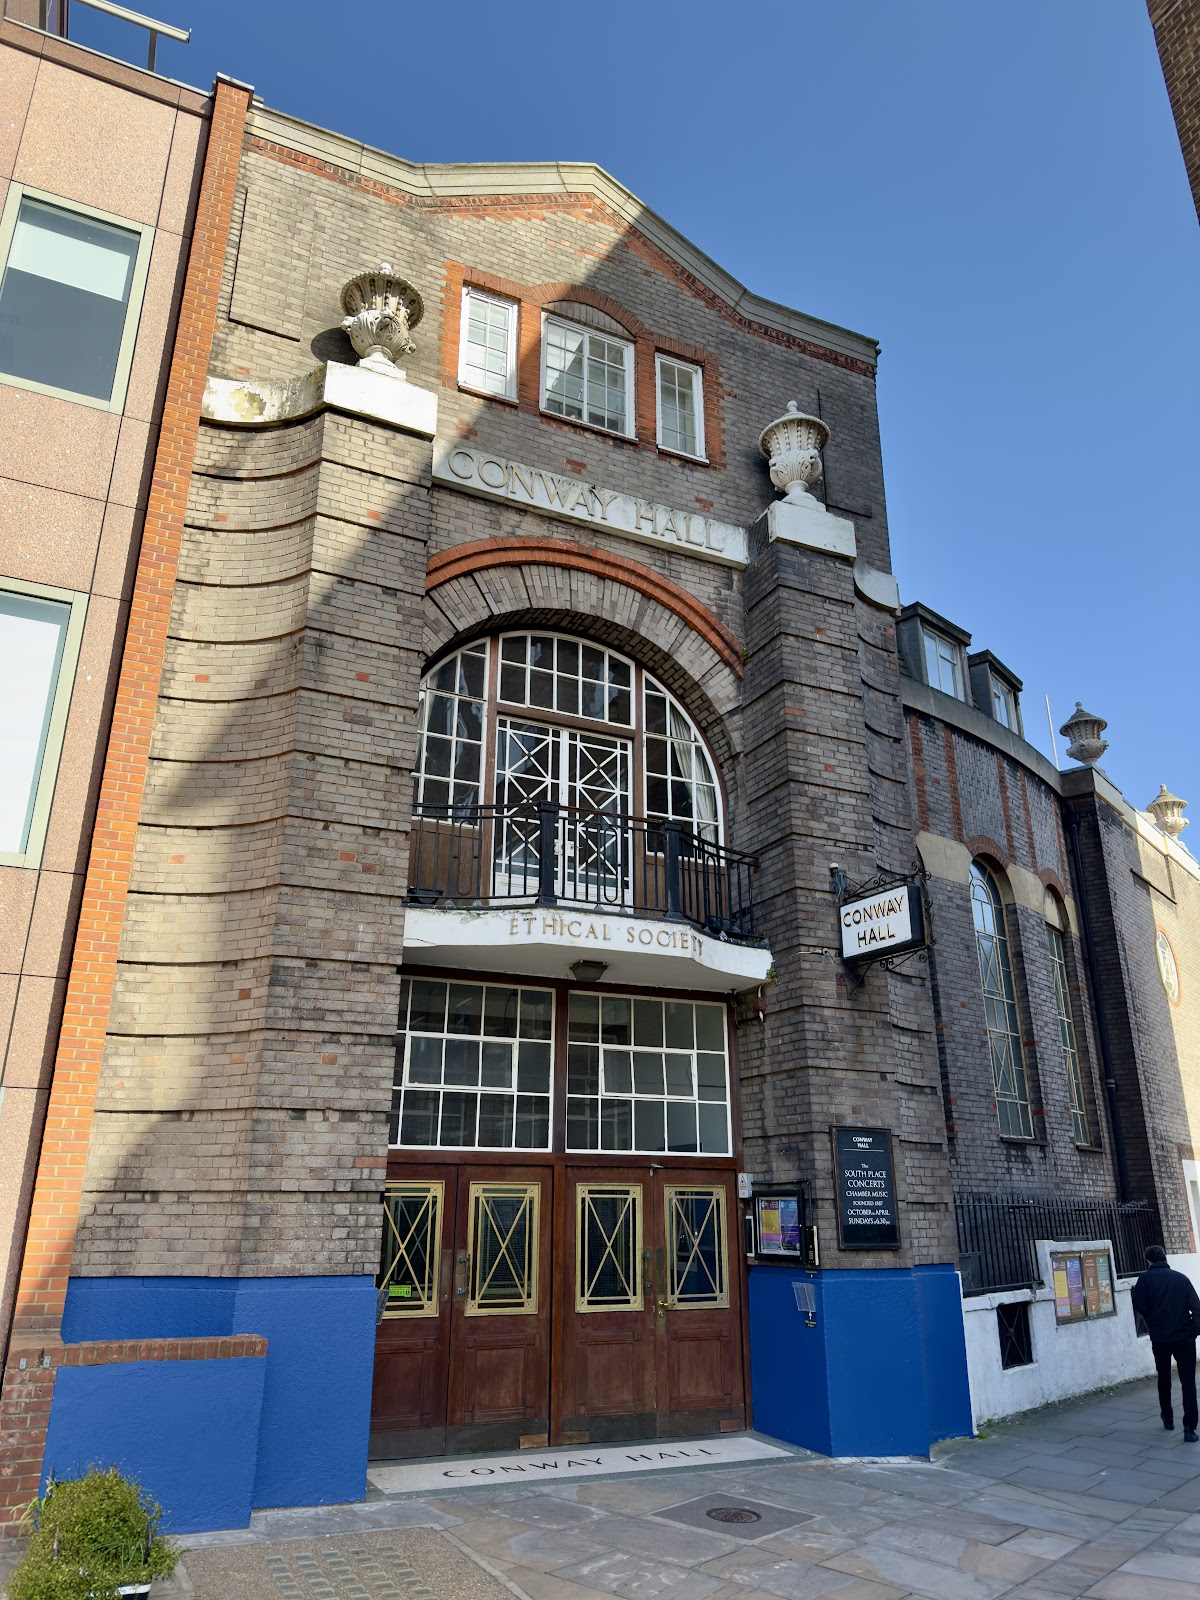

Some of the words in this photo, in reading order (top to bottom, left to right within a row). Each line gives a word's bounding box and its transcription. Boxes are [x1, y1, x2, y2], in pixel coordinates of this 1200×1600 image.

[448, 451, 617, 520] CONWAY
[634, 500, 725, 553] HALL
[843, 894, 905, 928] CONWAY
[509, 916, 612, 942] ETHICAL
[626, 926, 704, 956] SOCIETY
[857, 923, 896, 948] HALL
[844, 1169, 867, 1178] SOUTH
[868, 1170, 887, 1179] PLACE
[847, 1179, 885, 1188] CONCERTS
[845, 1190, 872, 1198] CHAMBER
[847, 1208, 872, 1216] OCTOBER
[848, 1217, 874, 1225] SUNDAYS
[442, 1457, 603, 1478] CONWAY
[625, 1447, 722, 1463] HALL
